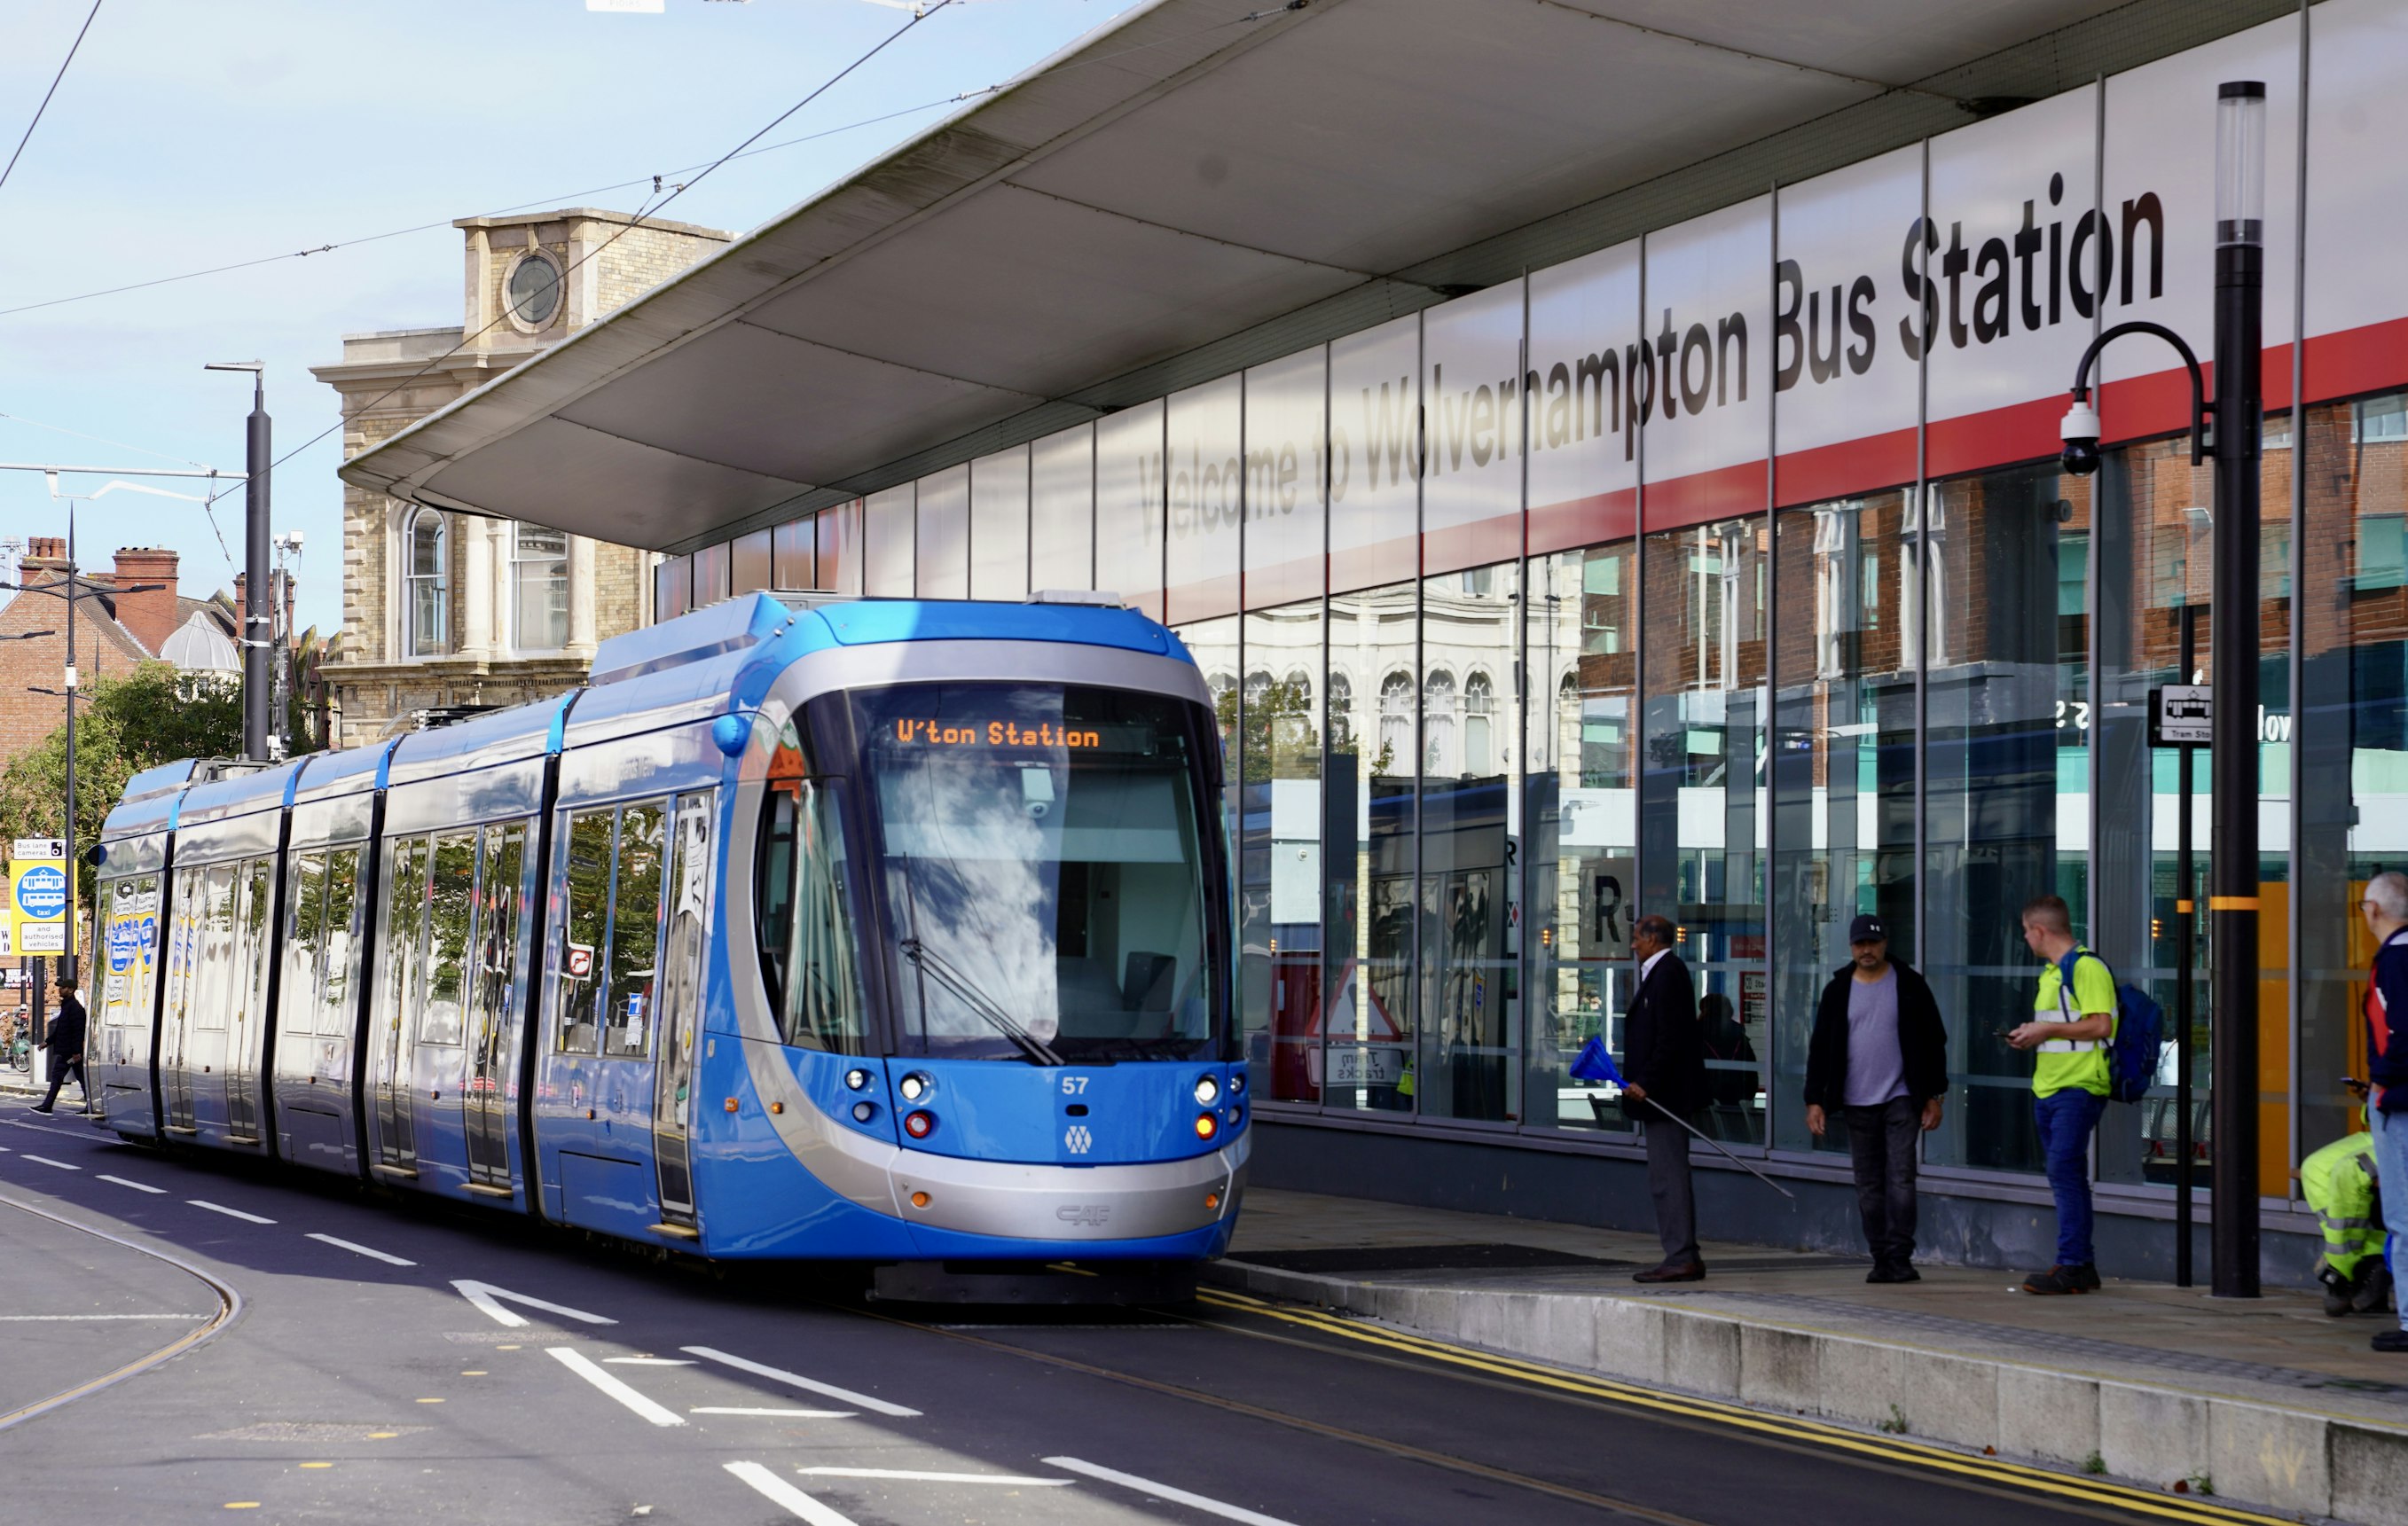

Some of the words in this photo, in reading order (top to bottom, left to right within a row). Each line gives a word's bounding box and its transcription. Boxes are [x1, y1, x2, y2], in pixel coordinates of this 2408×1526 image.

[1138, 435, 1298, 547] Welcome
[1313, 411, 1350, 505] to
[1362, 308, 1747, 490] Wolverhampton
[1775, 258, 1876, 393] Bus
[1899, 172, 2163, 361] Station
[988, 722, 1099, 747] Station
[2195, 730, 2212, 739] Sto
[1595, 875, 1622, 943] R
[1062, 1076, 1089, 1094] 57
[1055, 1205, 1110, 1226] CAF
